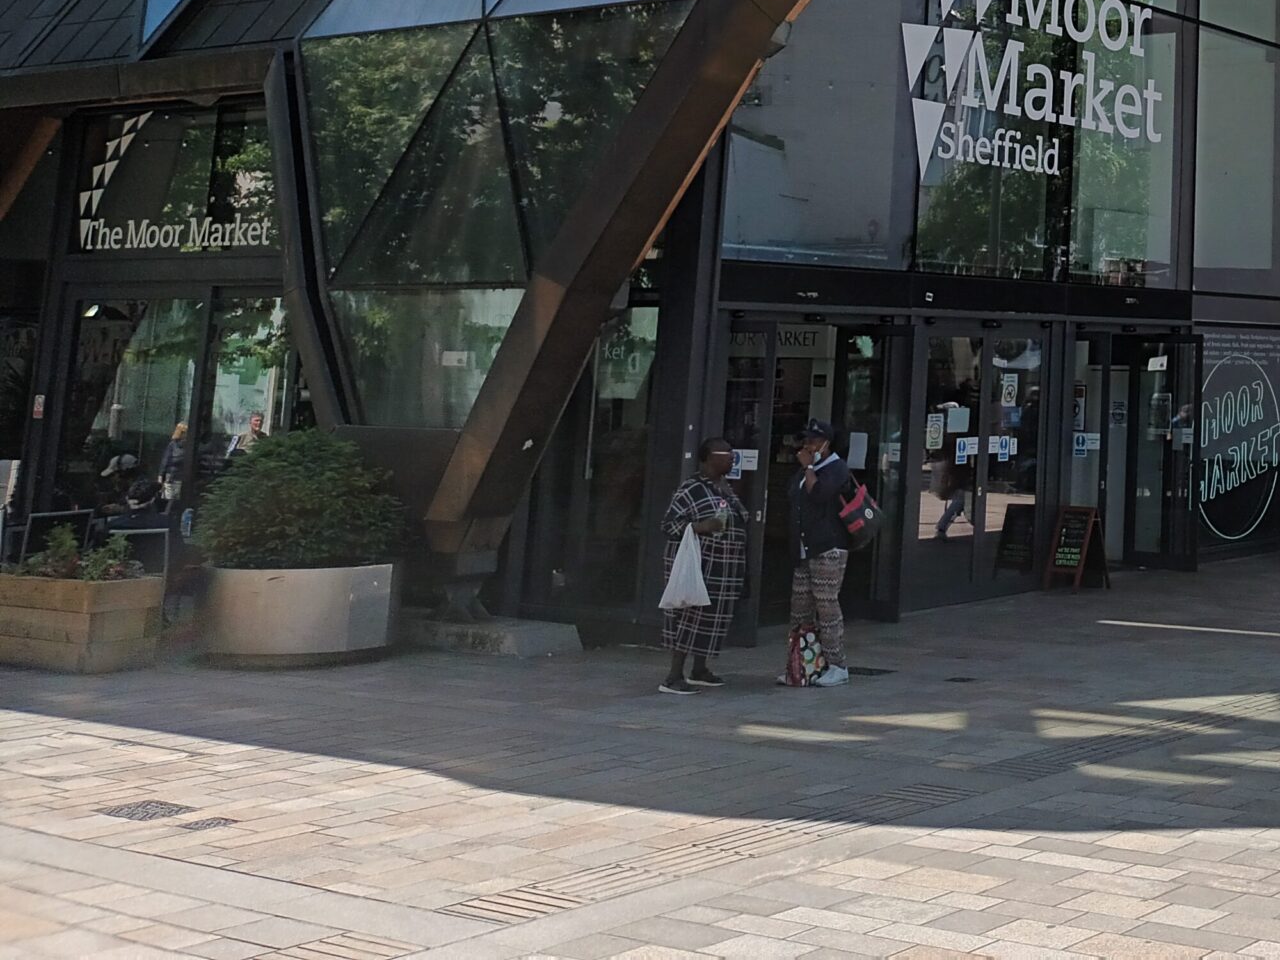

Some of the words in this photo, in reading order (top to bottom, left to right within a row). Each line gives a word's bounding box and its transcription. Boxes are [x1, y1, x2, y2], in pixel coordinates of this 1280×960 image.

[961, 31, 1163, 143] Market
[937, 121, 1060, 176] Sheffield
[85, 218, 123, 250] The
[124, 218, 185, 249] Moor
[187, 213, 271, 247] Market
[777, 331, 819, 347] ARKET
[1200, 380, 1264, 448] MOOR
